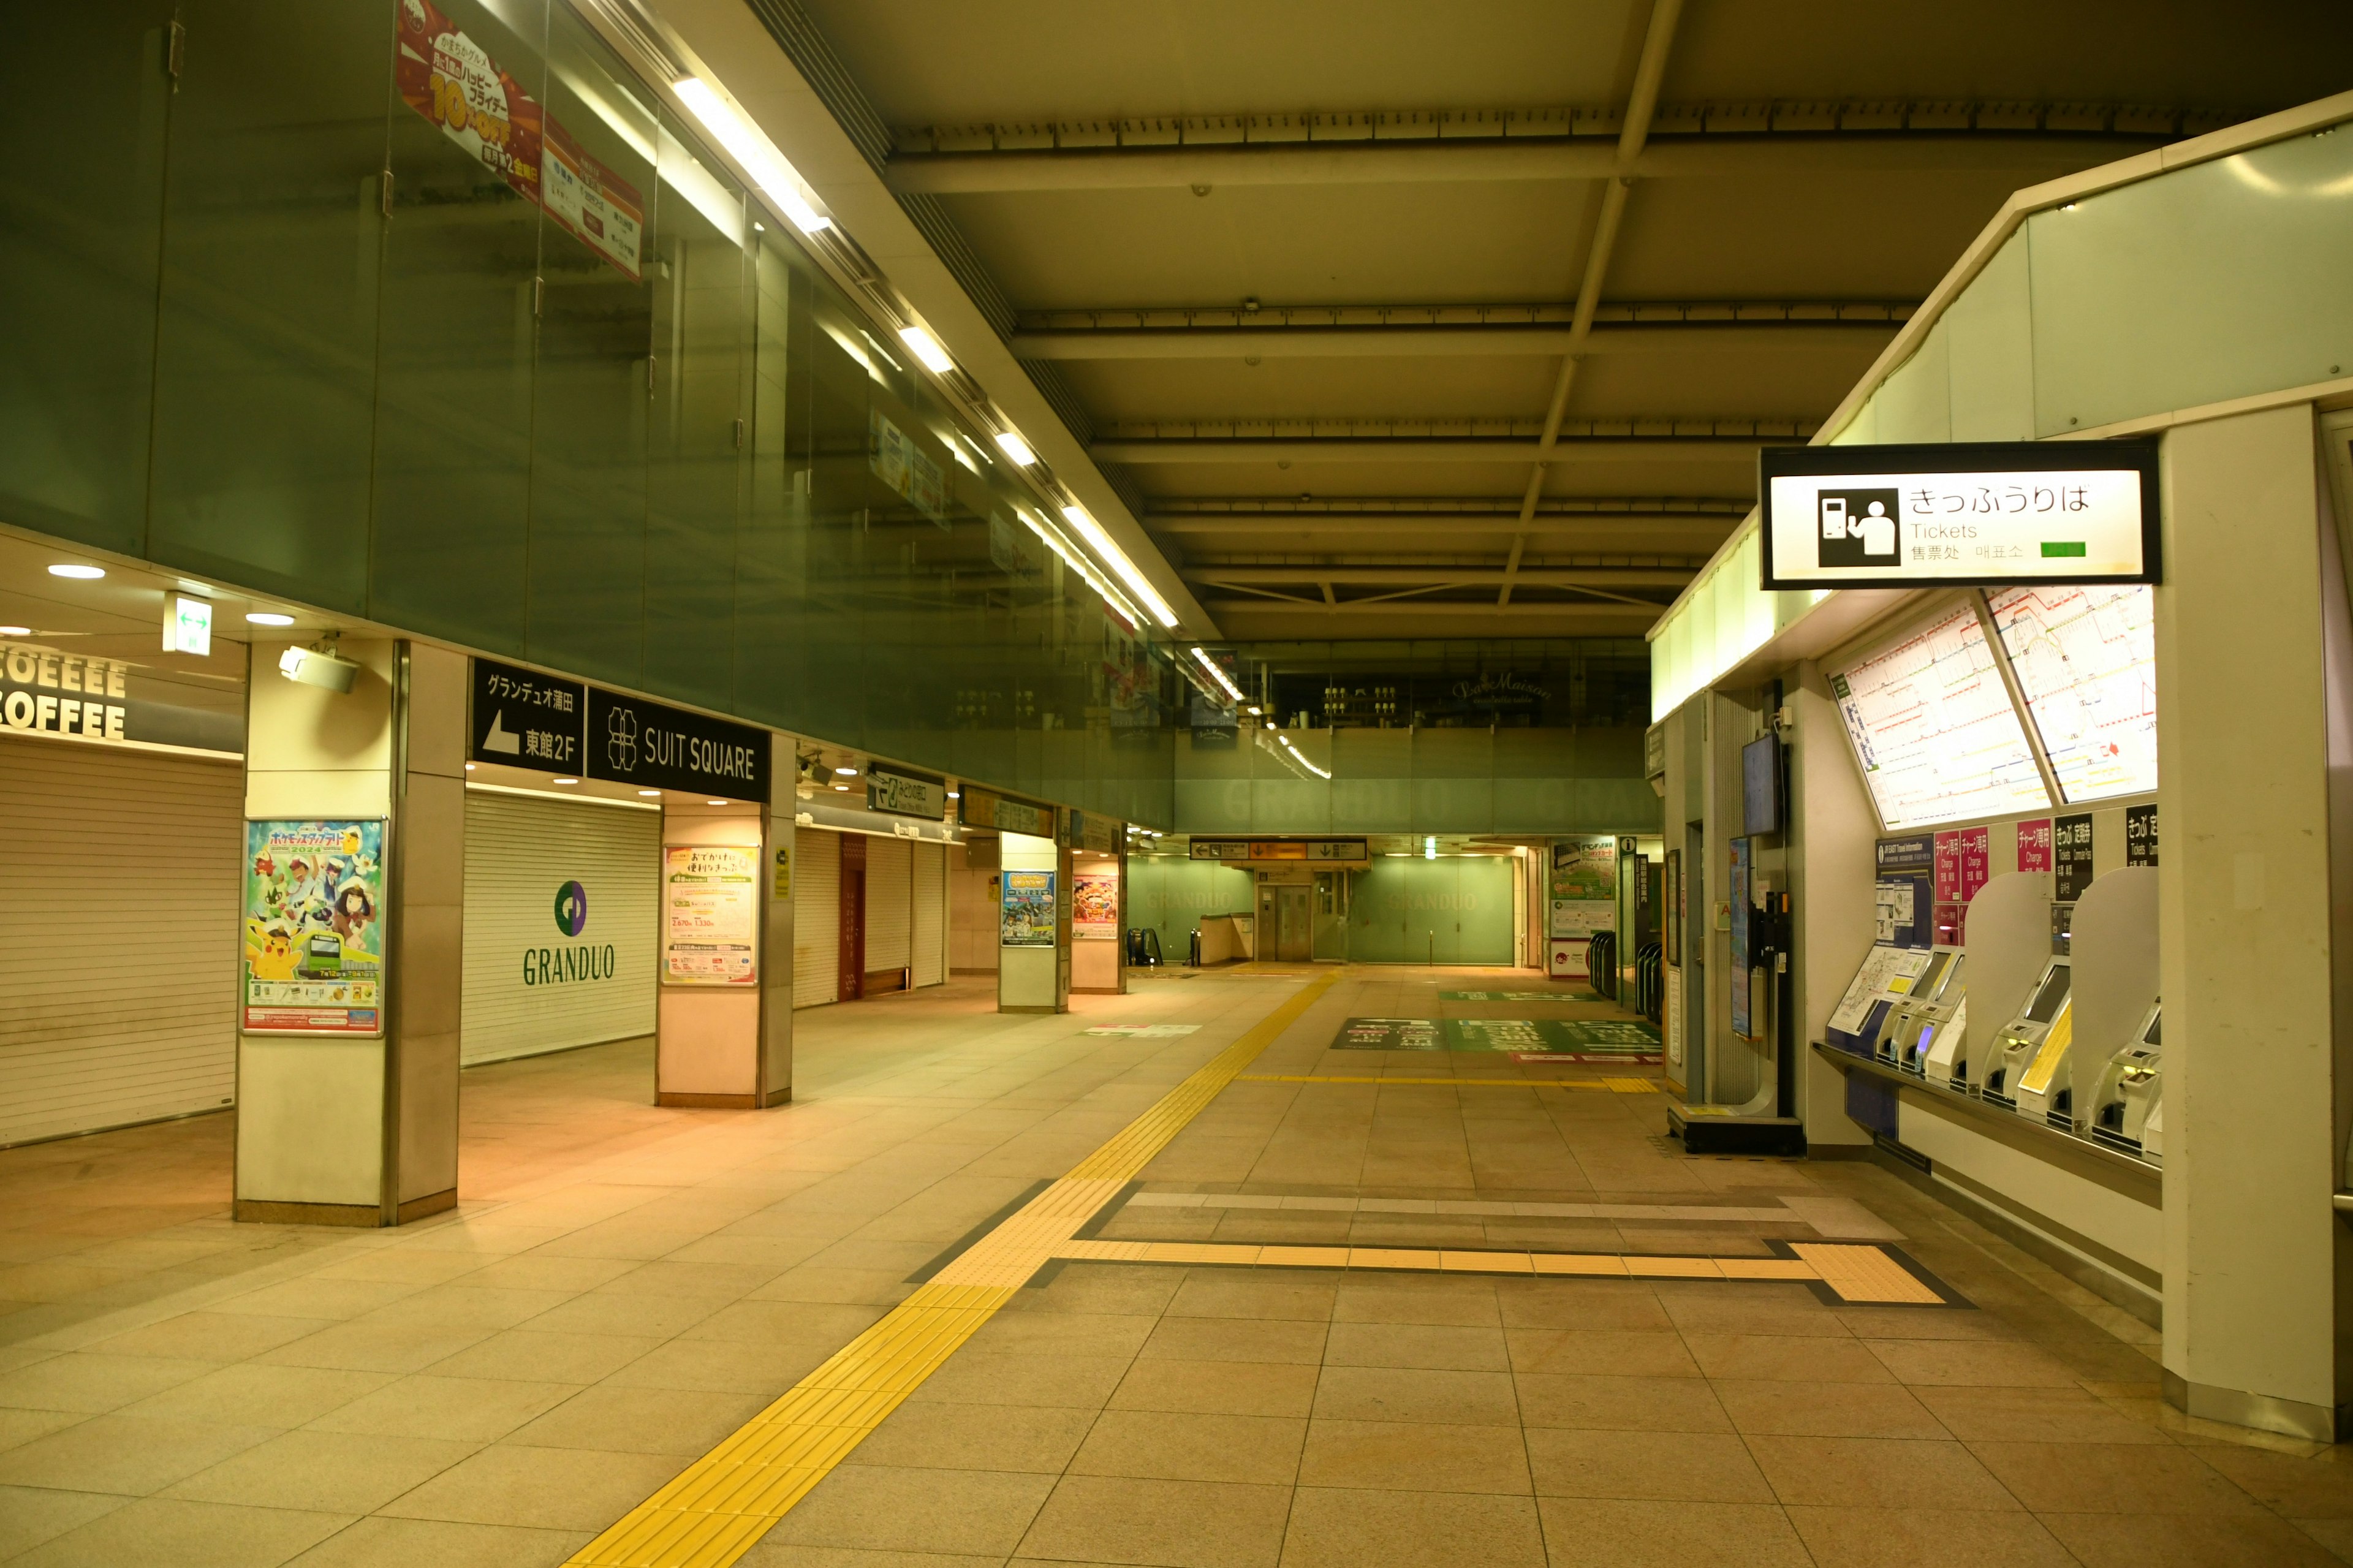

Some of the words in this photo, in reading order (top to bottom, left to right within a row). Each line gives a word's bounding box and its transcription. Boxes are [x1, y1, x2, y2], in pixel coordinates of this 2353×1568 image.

[463, 67, 492, 89] ハッピー
[469, 87, 507, 113] フライデー
[1909, 483, 2091, 514] きっぷうりば
[1911, 523, 1977, 539] Tickets
[1911, 544, 1960, 561] 售票处
[1975, 544, 2024, 560] 매표소
[488, 673, 574, 713] グランデュオ蒲田
[0, 691, 126, 740] OFFEE
[526, 729, 575, 762] 東館2F
[645, 727, 686, 768] SUIT
[690, 738, 755, 781] SQUARE
[2056, 824, 2072, 845] きっぷ
[2128, 814, 2148, 839] きっぷ
[2018, 827, 2050, 849] チャージ専用
[2131, 843, 2146, 855] Tickets
[1941, 858, 1953, 870] Charge
[1968, 857, 1981, 869] Charge
[2026, 852, 2042, 865] Charge
[2058, 849, 2071, 861] Tickets
[687, 863, 737, 873] 便利なきっぷ
[523, 944, 614, 985] GRANDUO
